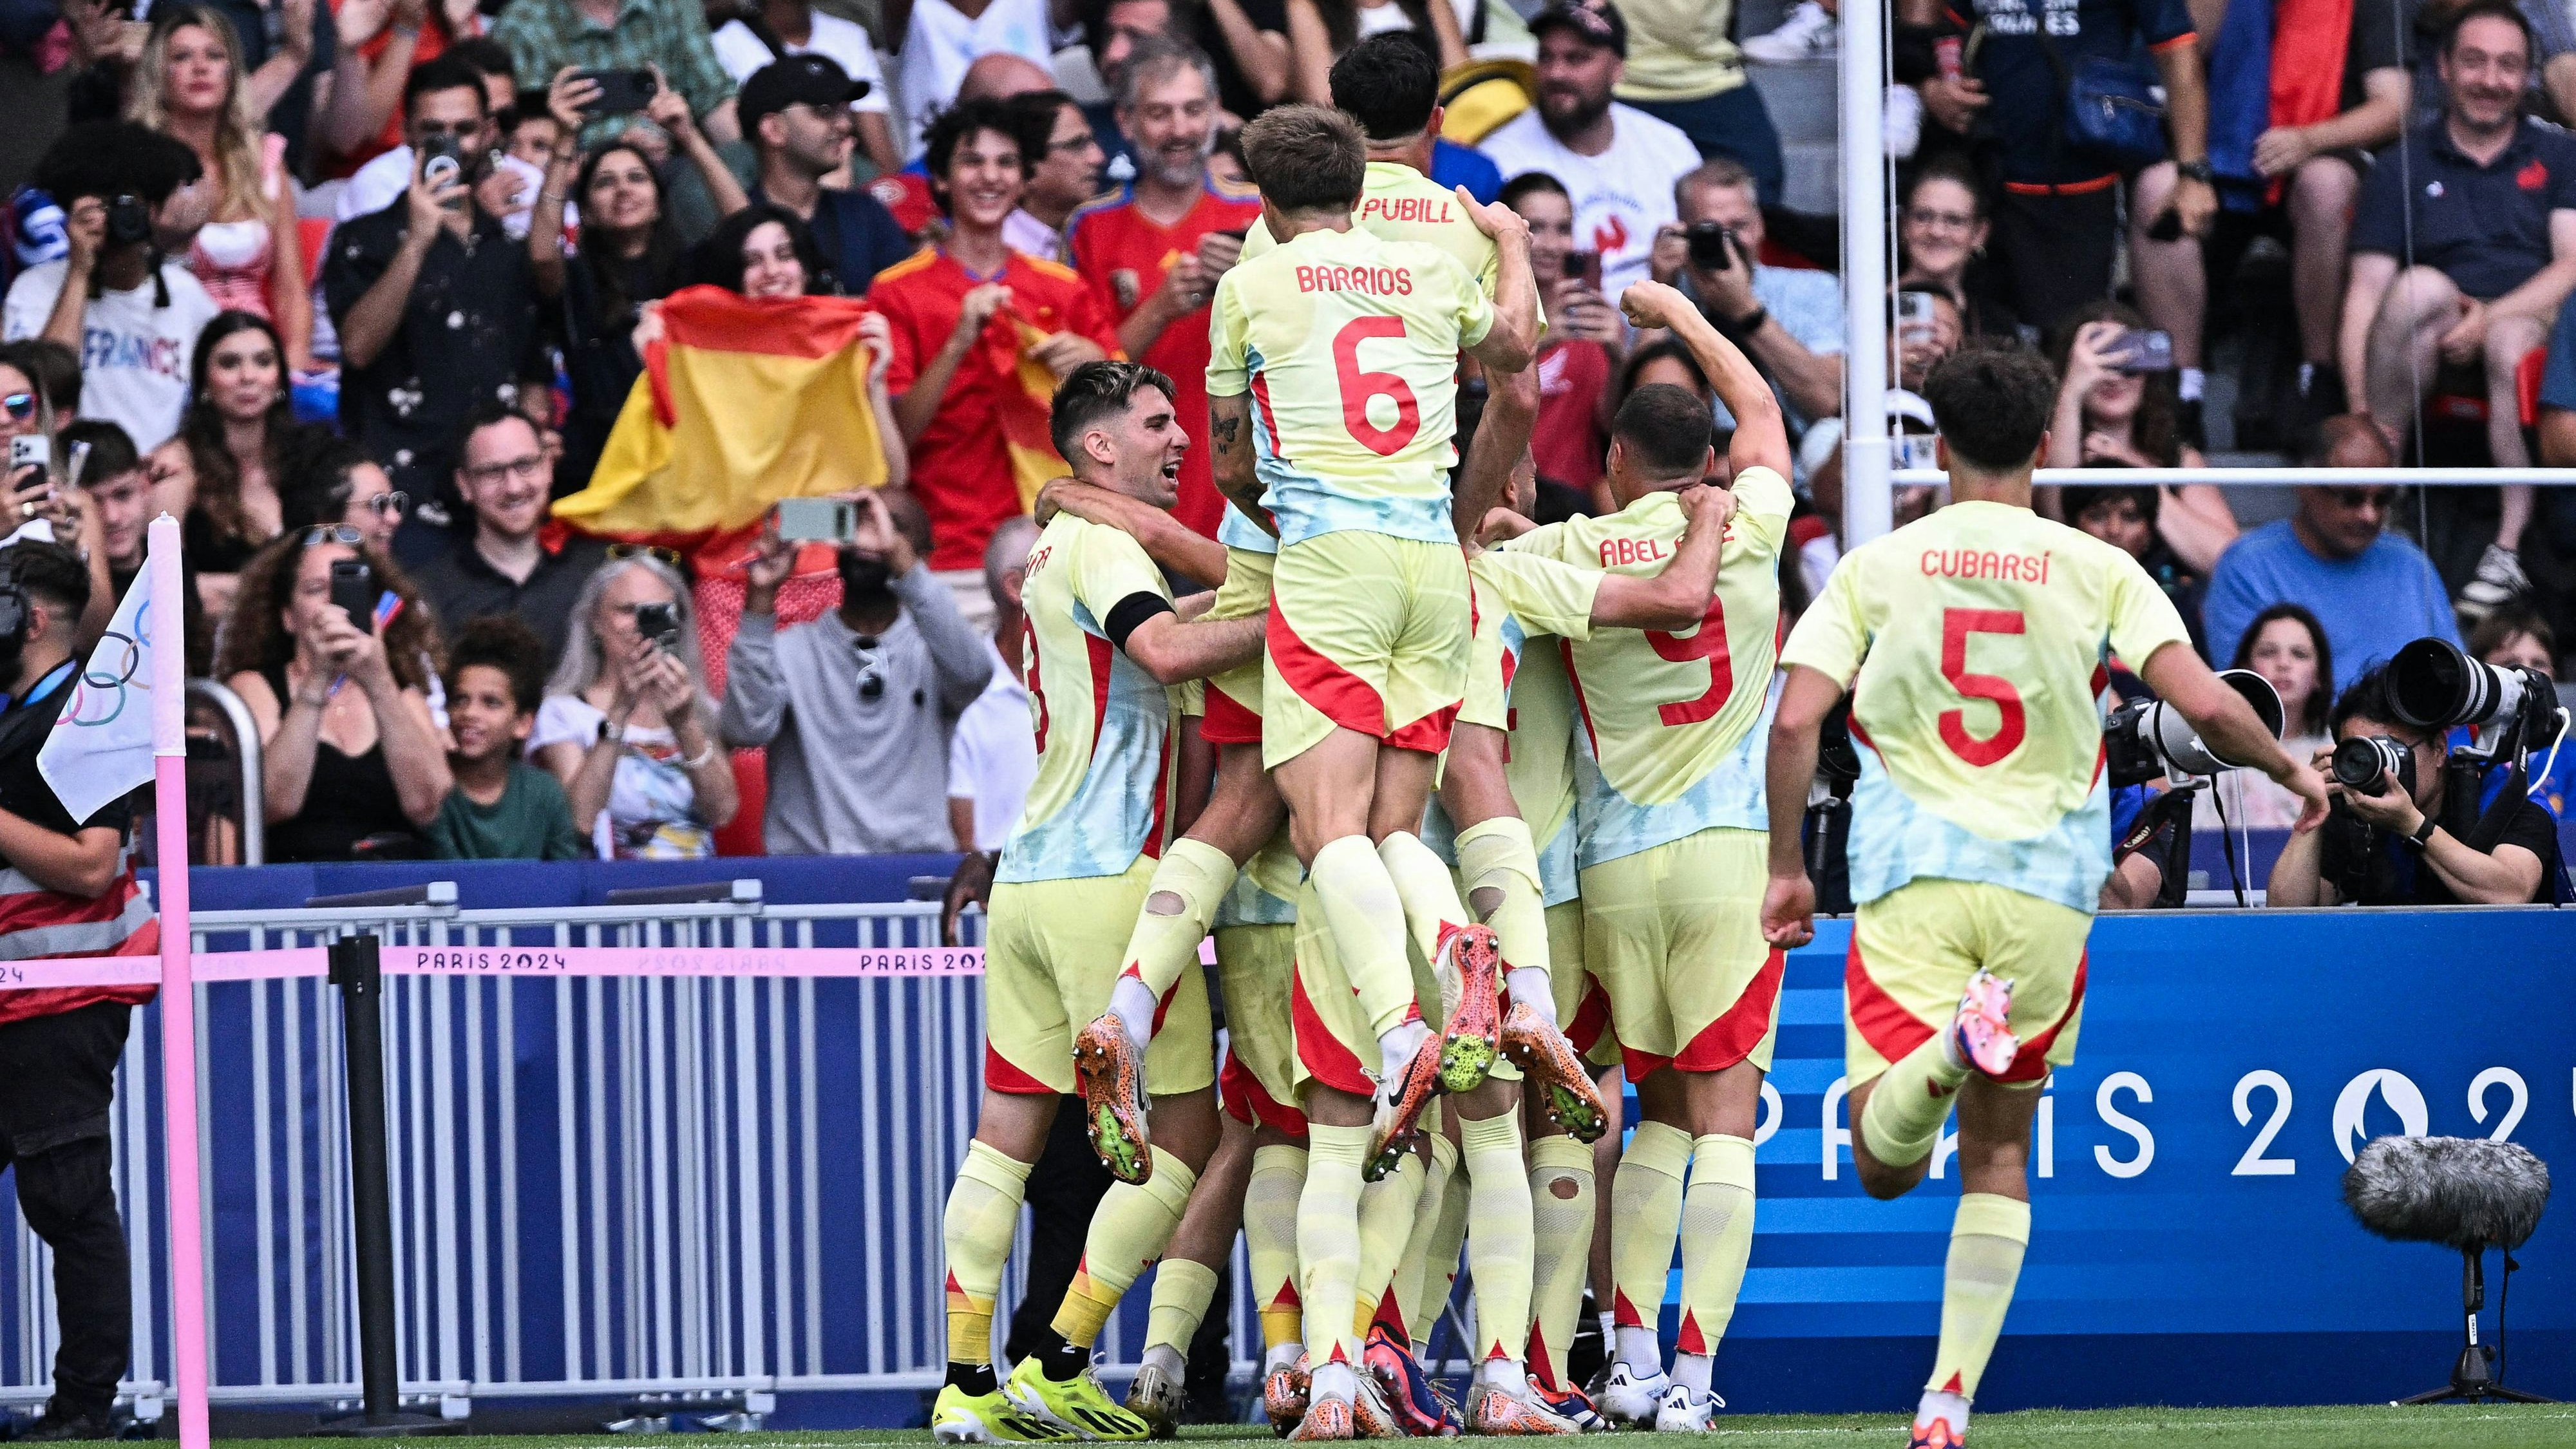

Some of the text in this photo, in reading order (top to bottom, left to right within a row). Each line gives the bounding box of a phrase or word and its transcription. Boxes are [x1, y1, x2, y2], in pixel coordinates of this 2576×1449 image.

[1361, 198, 1454, 223] PUBILL
[1296, 265, 1412, 296] BARRIOS
[1332, 316, 1420, 456] 6
[1599, 538, 1668, 568] ABEL
[1921, 549, 2050, 585] CUBARSÍ
[1643, 594, 1733, 726] 9
[1938, 607, 2025, 766] 5
[500, 953, 565, 969] 2024
[2231, 1066, 2576, 1175] 202
